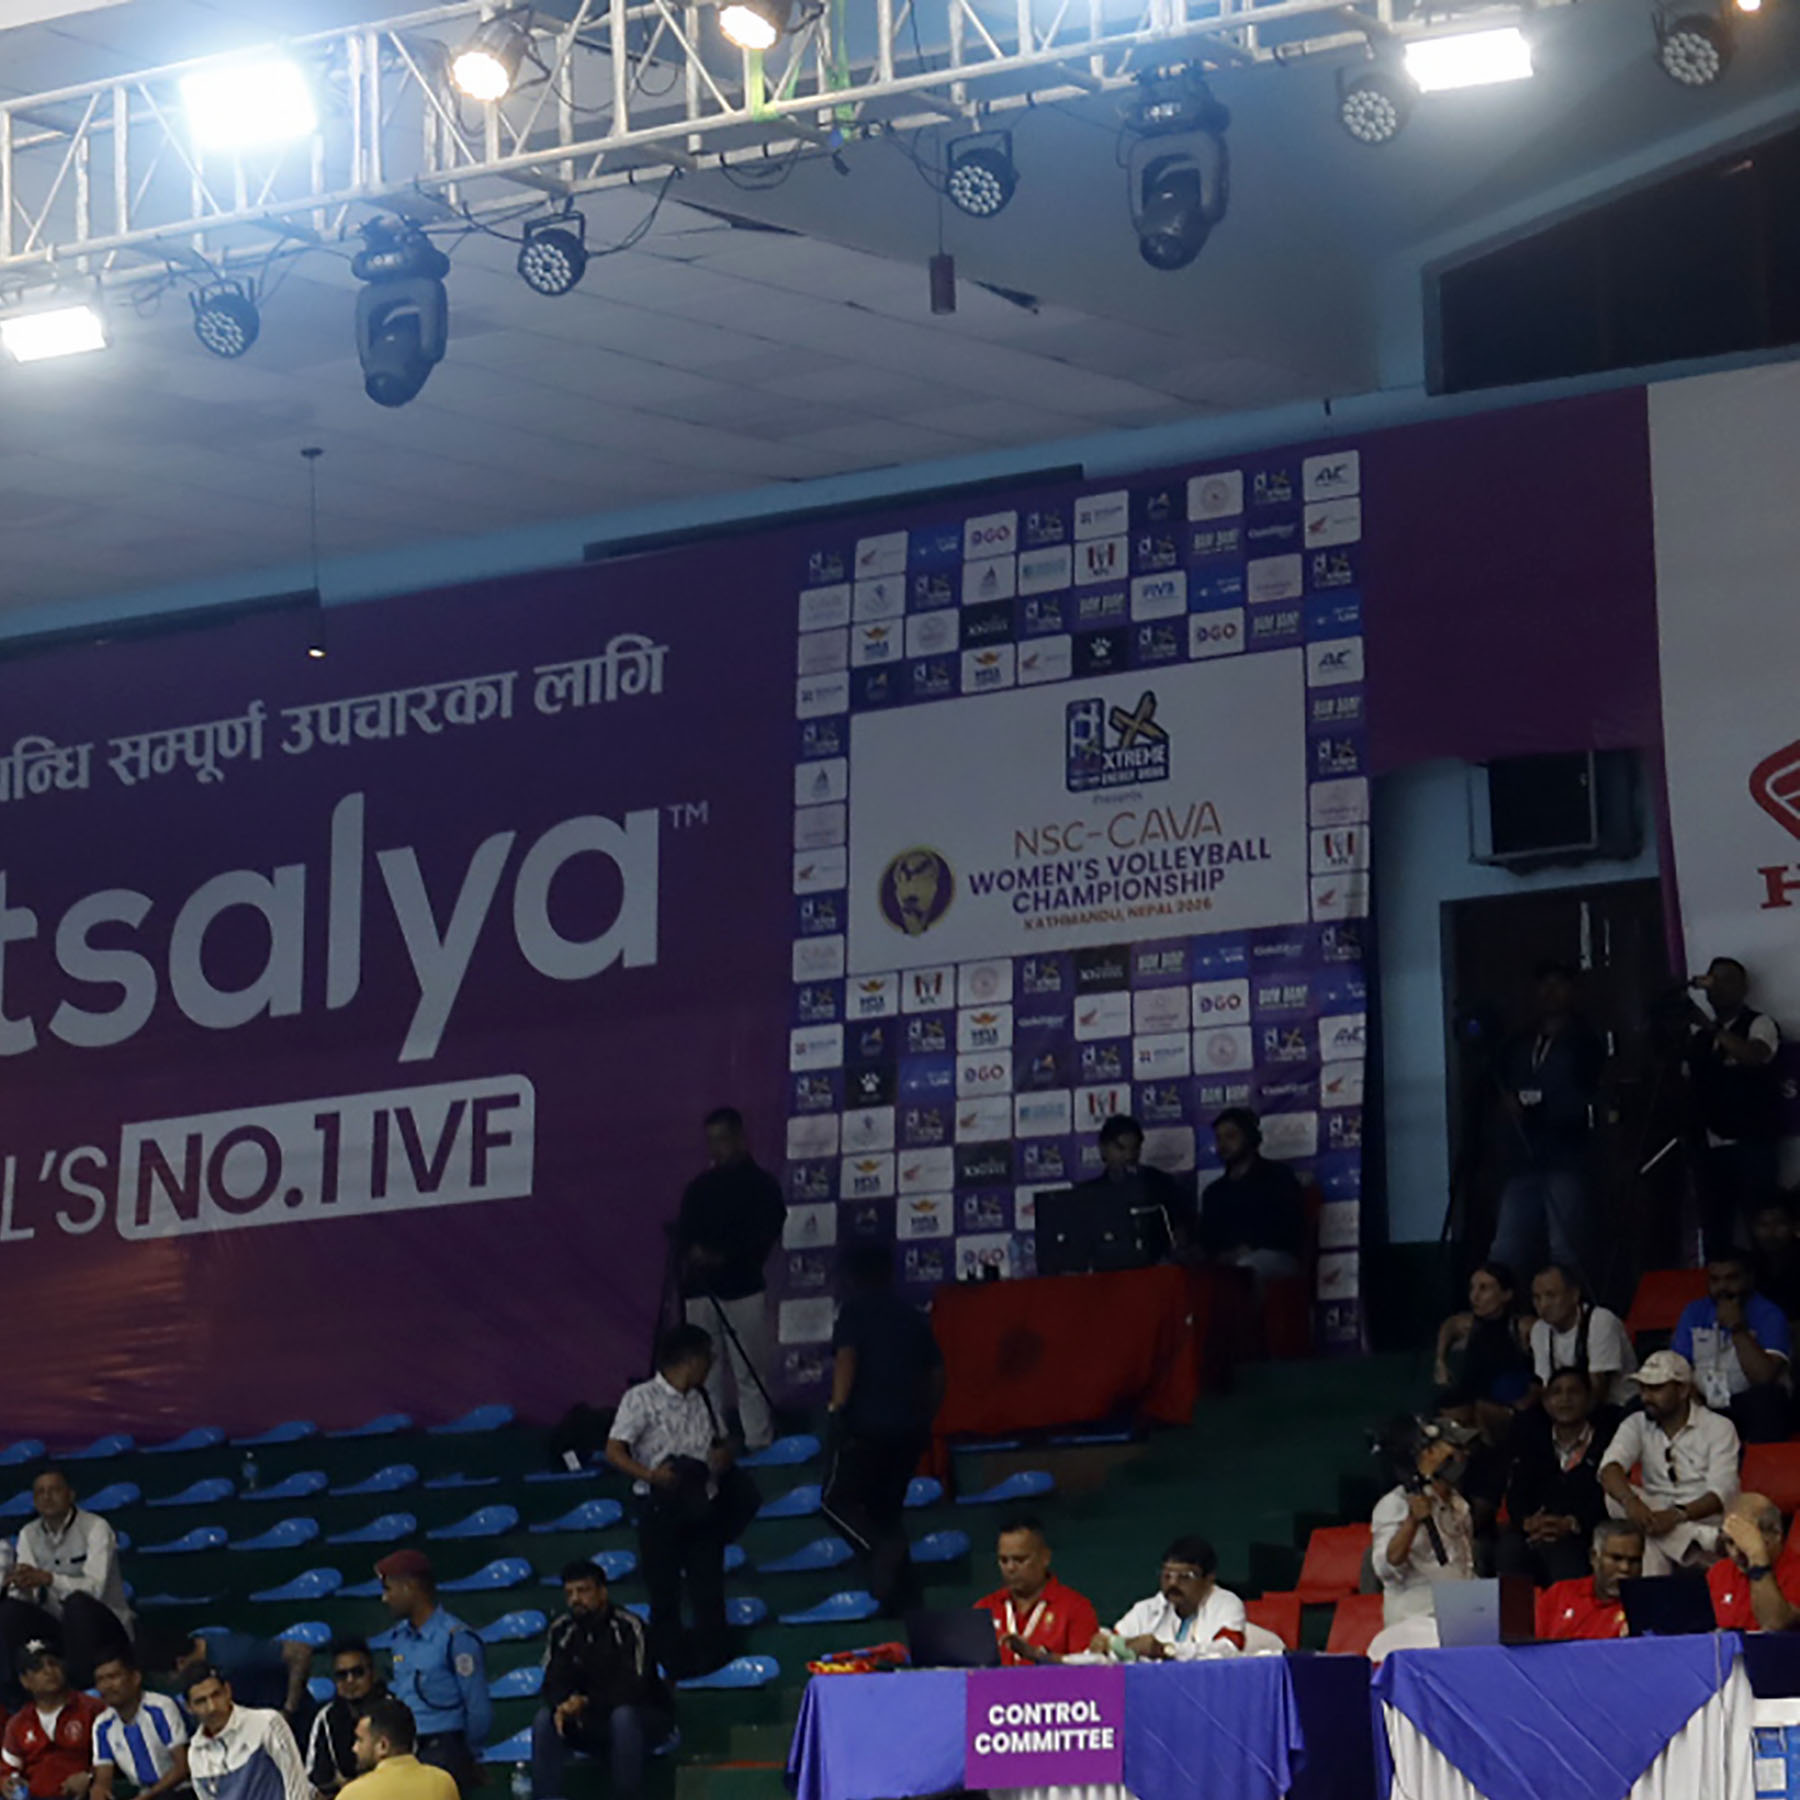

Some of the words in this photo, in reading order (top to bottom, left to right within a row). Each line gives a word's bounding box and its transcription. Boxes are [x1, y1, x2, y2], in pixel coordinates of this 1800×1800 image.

[108, 699, 267, 785] सम्पूर्ण
[280, 671, 520, 755] उपचारका
[533, 633, 671, 714] लागि
[1102, 743, 1166, 771] XTREME
[1014, 801, 1222, 859] NSC-CAVA
[969, 858, 1099, 896] WOMEN'S
[1108, 837, 1271, 877] VOLLEYBALL
[1012, 868, 1225, 914] CHAMPIONSHIP
[1128, 903, 1173, 919] NEPAL
[133, 1113, 343, 1228] NO.1
[369, 1093, 522, 1199] IVF
[988, 1700, 1101, 1726] CONTROL
[975, 1728, 1115, 1754] COMMITTEE
